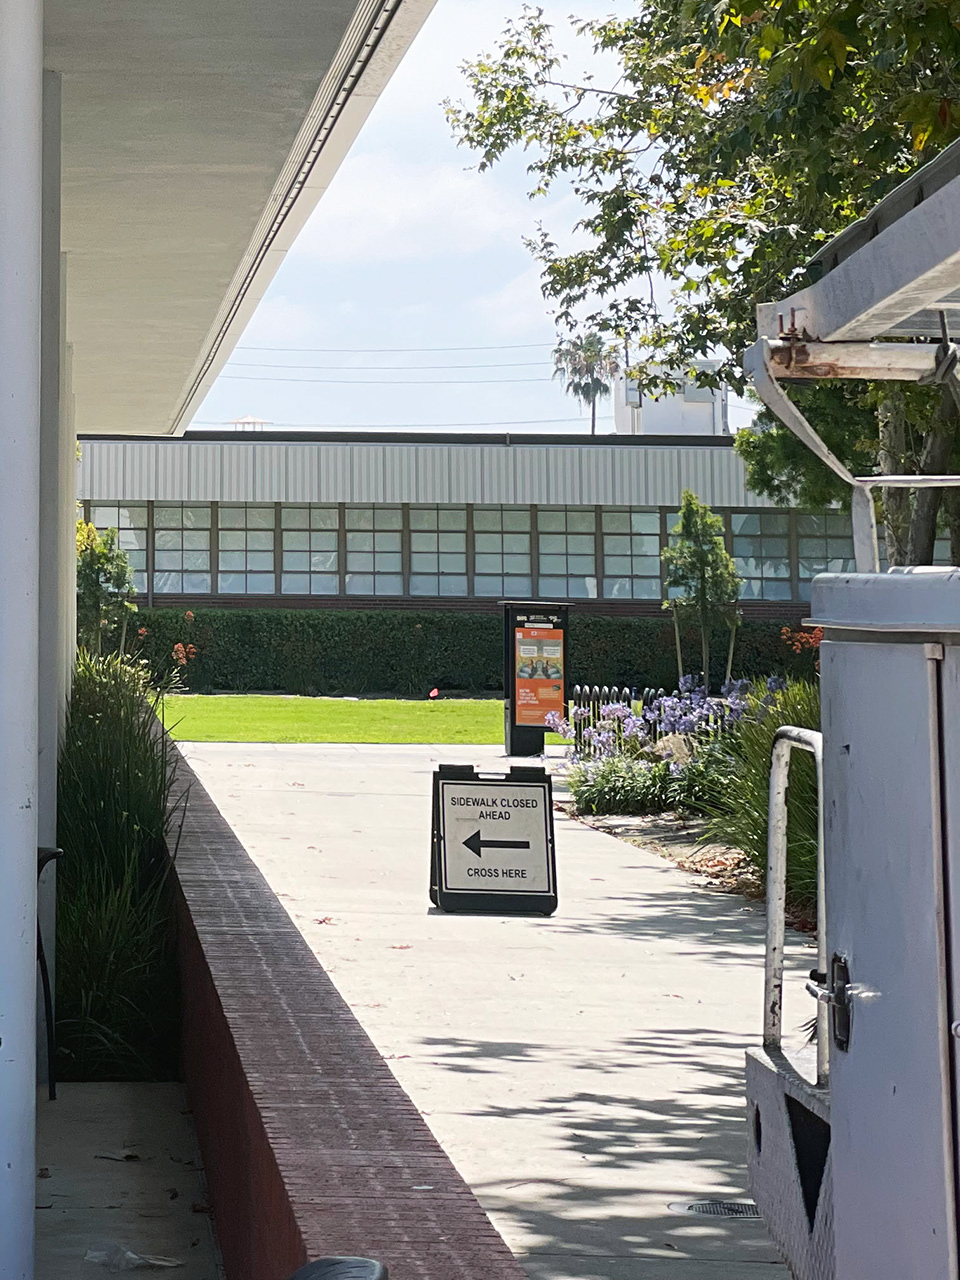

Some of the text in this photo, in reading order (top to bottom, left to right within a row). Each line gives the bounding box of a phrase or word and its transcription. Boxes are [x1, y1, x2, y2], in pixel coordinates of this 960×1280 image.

[450, 796, 538, 809] SIDEWALK CLOSED
[478, 810, 511, 821] AHEAD
[467, 867, 528, 879] CROSS HERE
